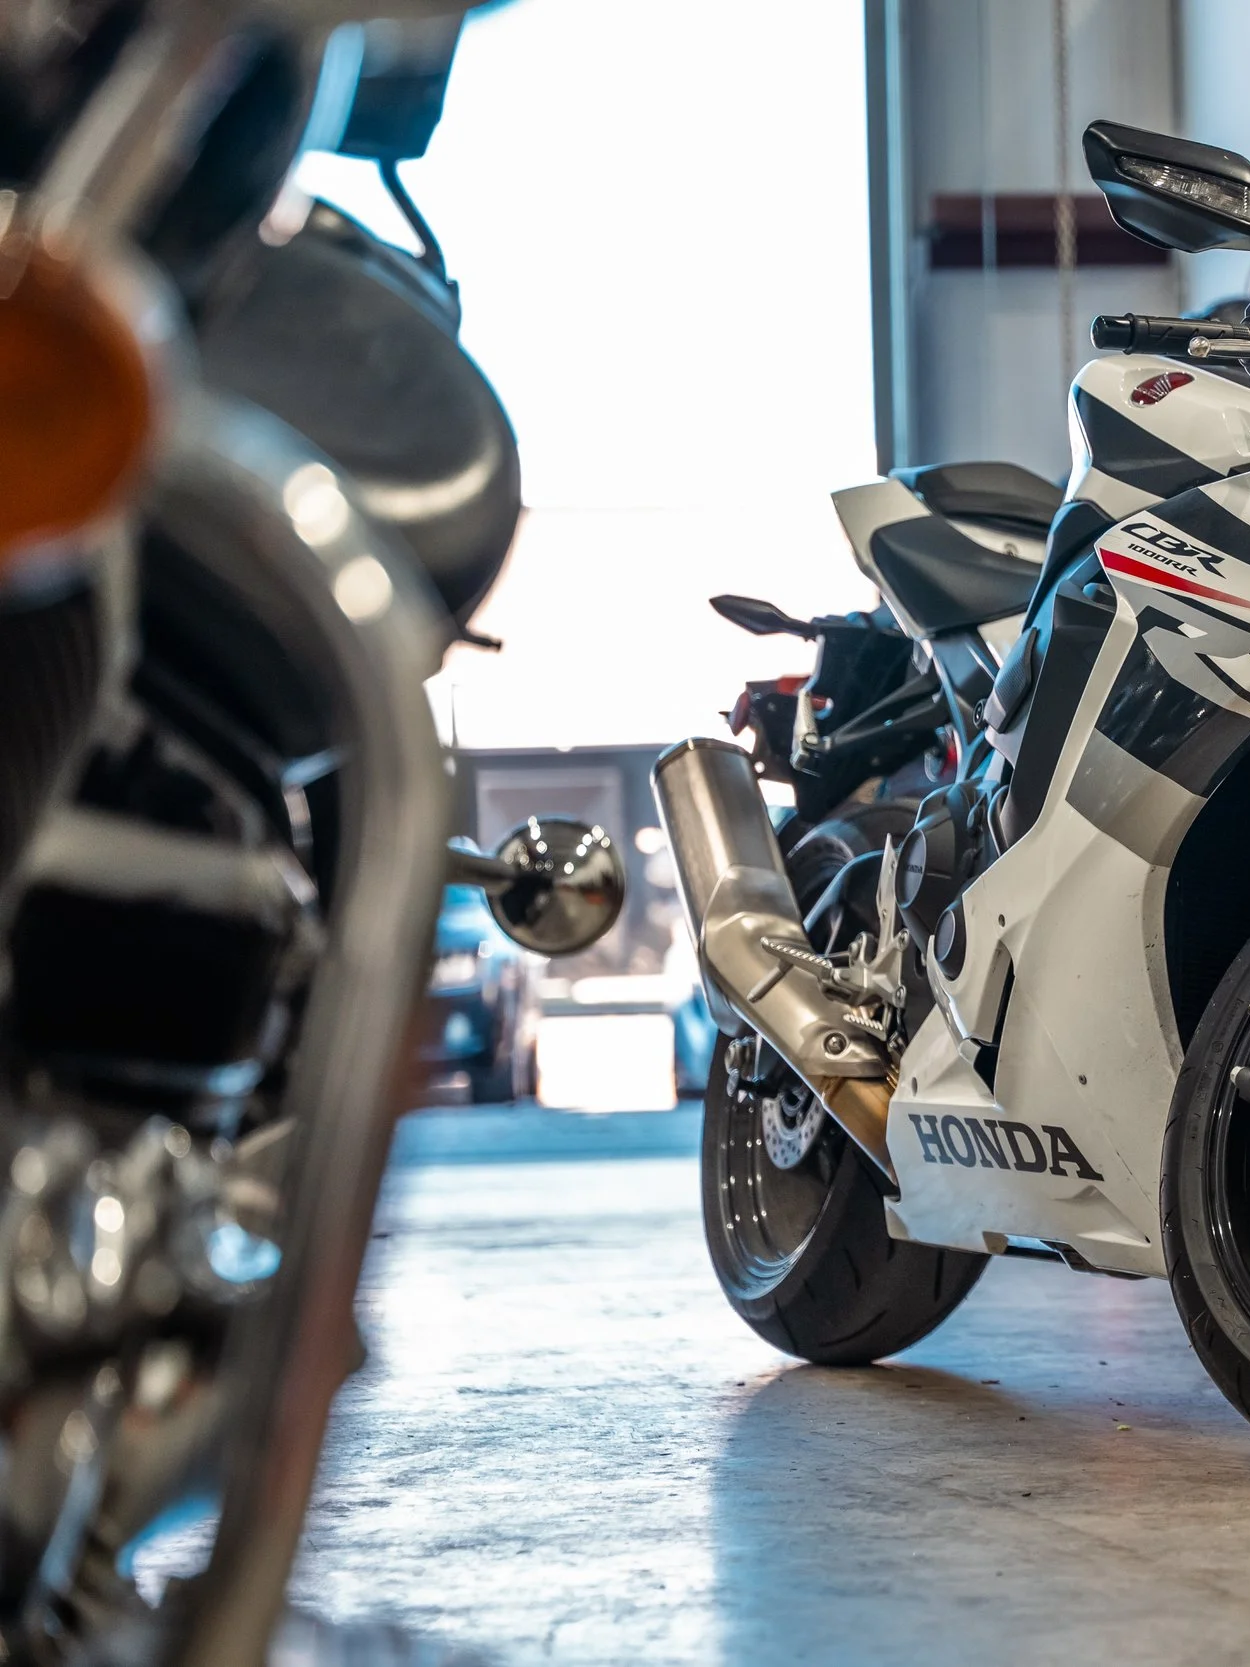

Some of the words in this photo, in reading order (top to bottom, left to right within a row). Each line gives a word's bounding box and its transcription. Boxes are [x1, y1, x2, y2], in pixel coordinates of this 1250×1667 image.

[1120, 523, 1227, 580] CBR
[1128, 544, 1198, 577] 1000RR
[908, 1114, 1105, 1181] HONDA
